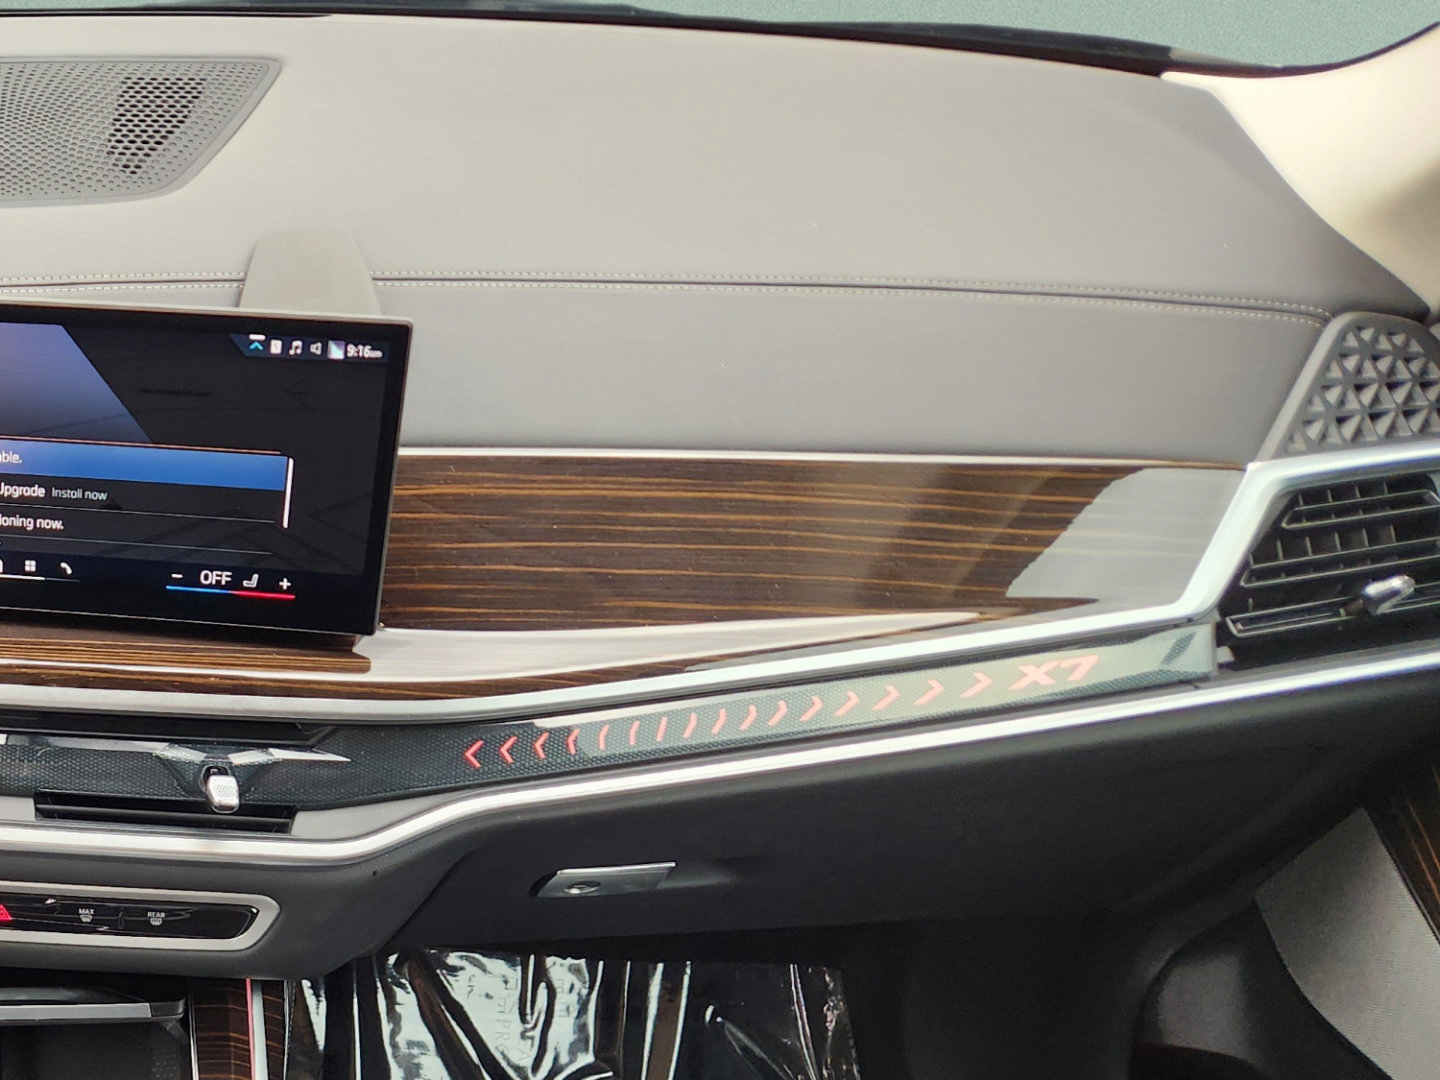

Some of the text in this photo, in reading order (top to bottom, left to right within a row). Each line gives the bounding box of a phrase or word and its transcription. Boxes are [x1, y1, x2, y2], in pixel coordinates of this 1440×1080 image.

[51, 487, 83, 499] Install
[84, 491, 108, 500] now
[36, 518, 64, 530] now.
[200, 570, 233, 585] OFF
[1009, 654, 1099, 690] X7
